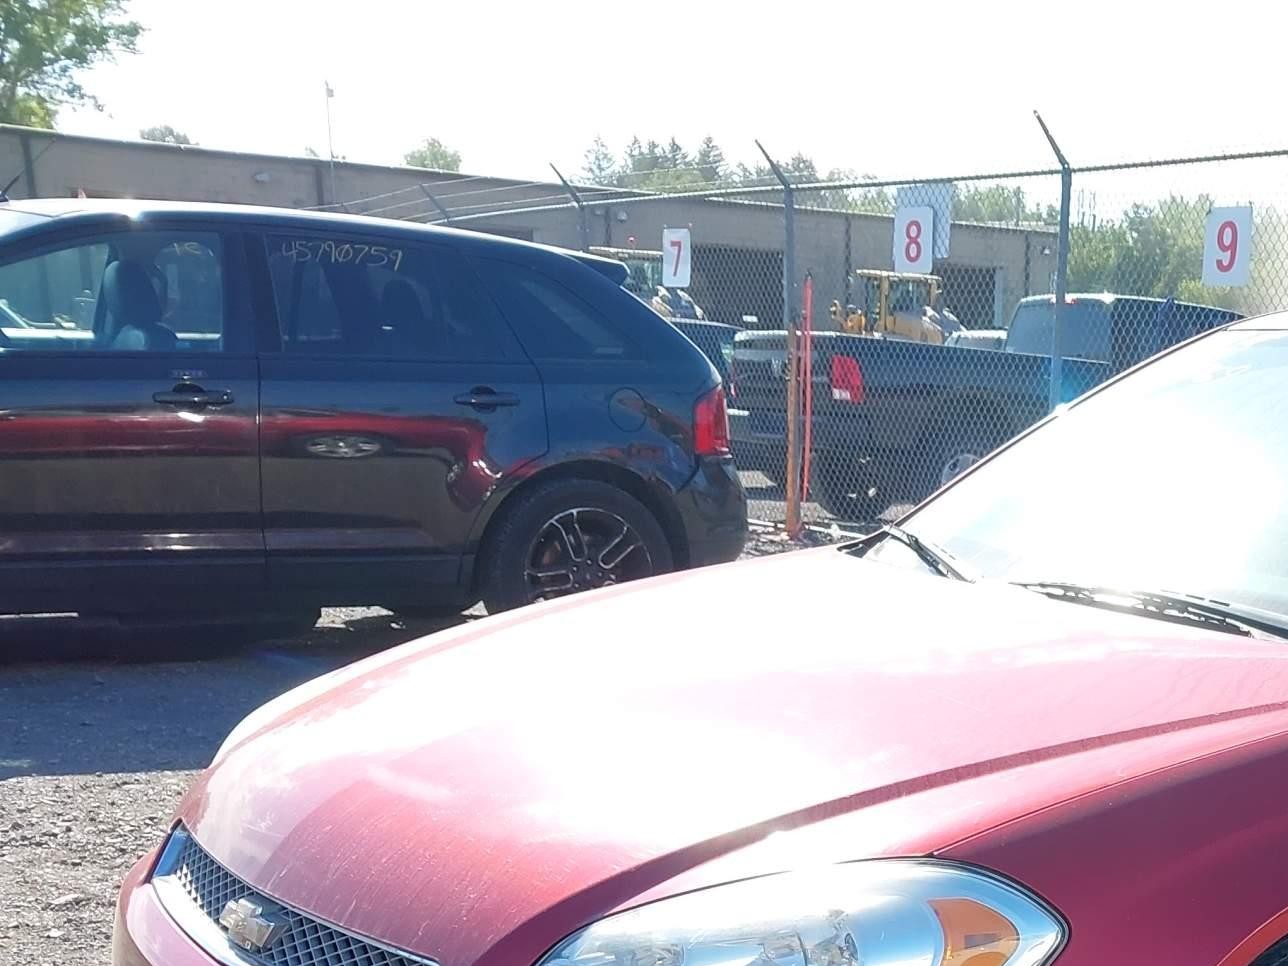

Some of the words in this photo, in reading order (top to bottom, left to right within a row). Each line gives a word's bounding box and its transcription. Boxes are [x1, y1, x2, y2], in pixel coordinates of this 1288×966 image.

[282, 240, 403, 272] 45790759
[670, 240, 682, 277] 7
[905, 220, 922, 263] 8
[1215, 220, 1238, 273] 9
